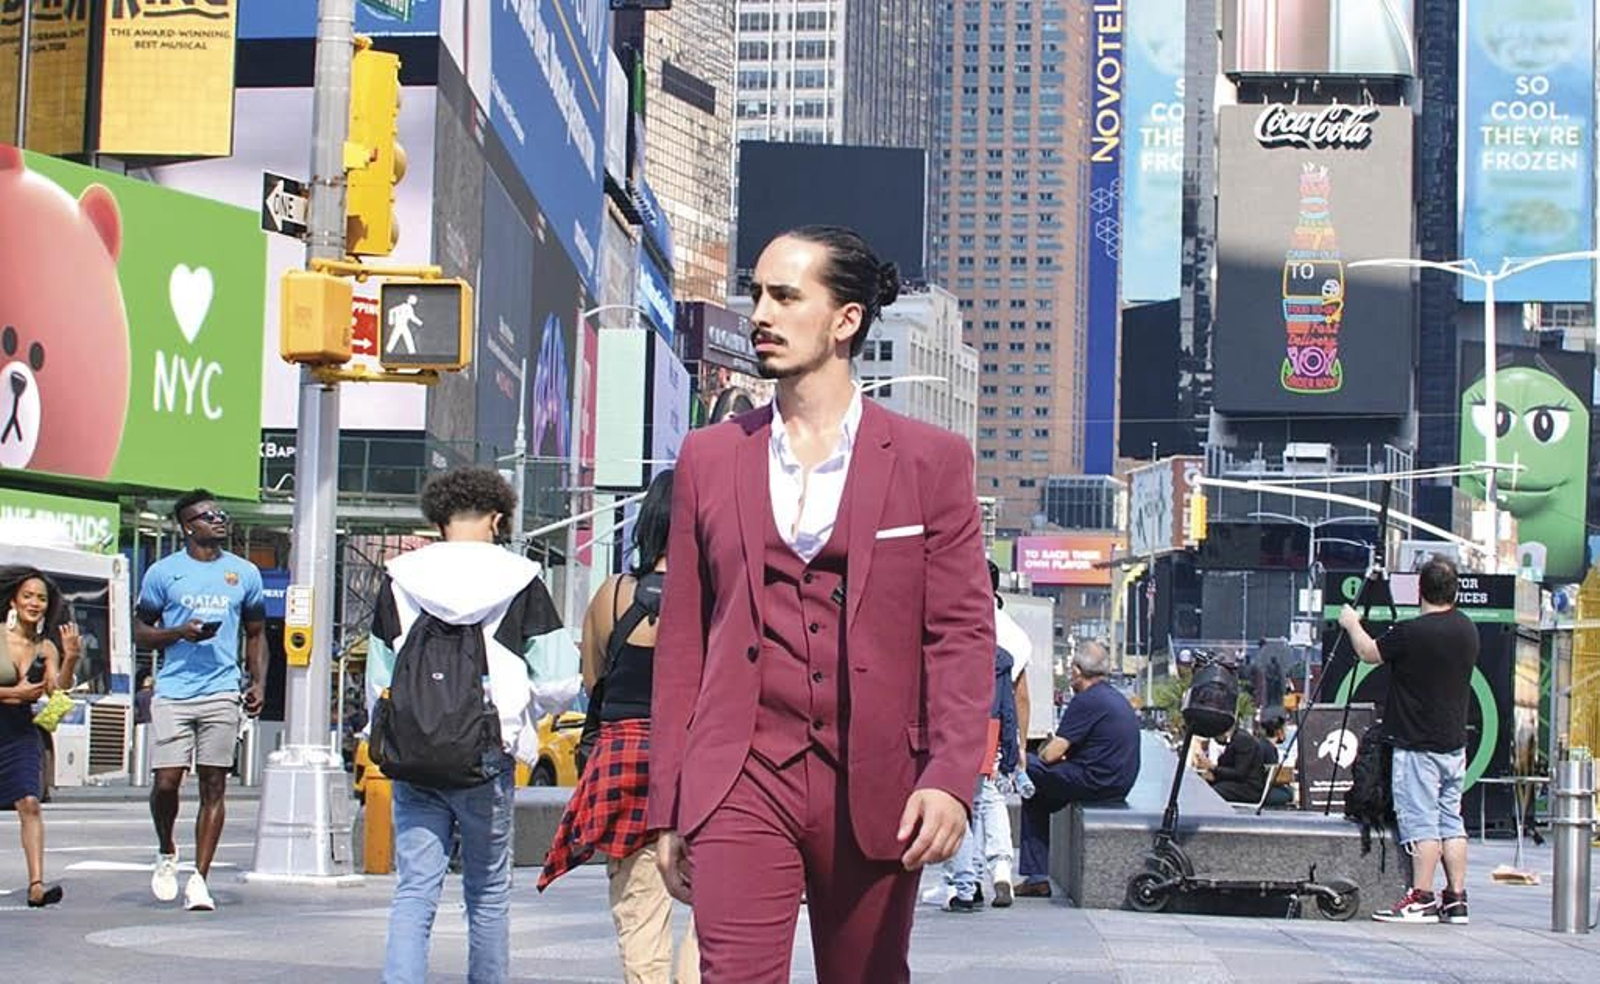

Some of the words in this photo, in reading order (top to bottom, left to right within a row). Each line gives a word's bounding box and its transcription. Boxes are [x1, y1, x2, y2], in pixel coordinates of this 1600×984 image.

[111, 28, 130, 37] THE
[134, 40, 158, 49] BEST
[160, 41, 208, 50] MUSICAL
[1091, 0, 1123, 162] NOVOTEL
[1515, 76, 1550, 95] SO
[1491, 101, 1570, 120] COOL.
[1481, 126, 1580, 146] THEY'RE
[1482, 151, 1578, 171] FROZEN
[273, 193, 294, 219] ONE
[1289, 262, 1314, 279] TO
[153, 349, 222, 420] NYC
[1025, 549, 1039, 559] TO
[1025, 560, 1050, 568] OWN
[181, 595, 229, 609] QATAR
